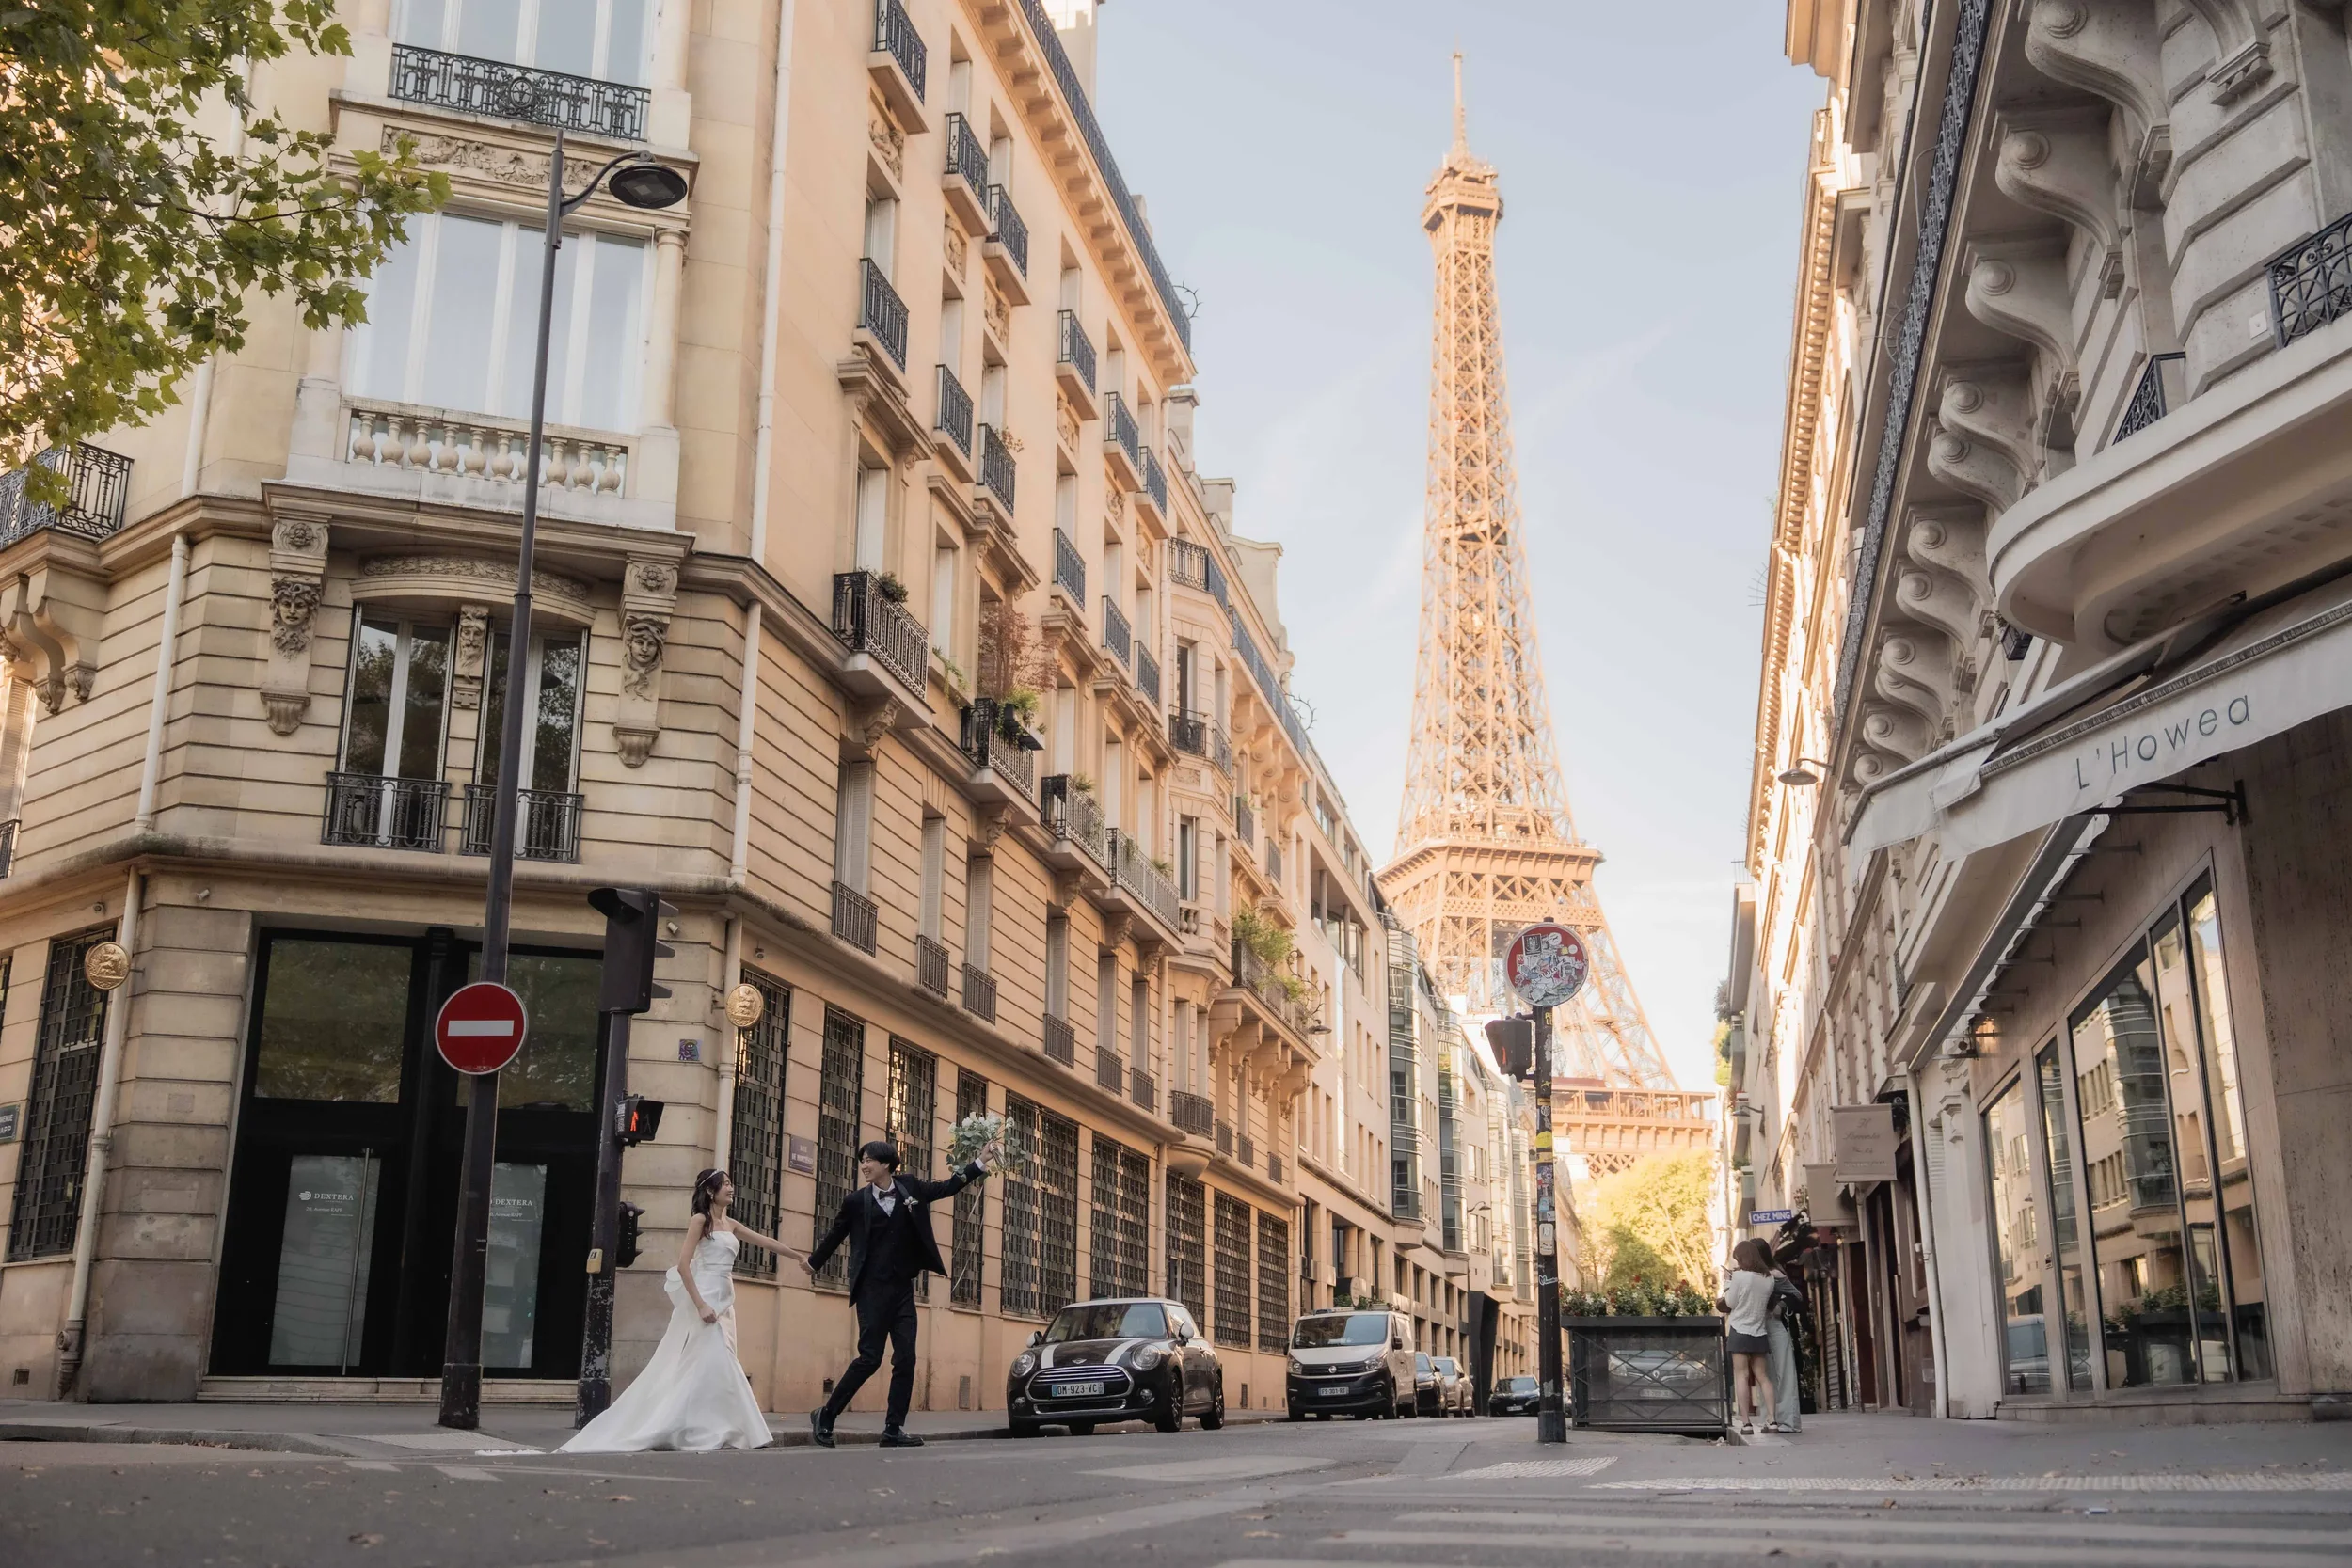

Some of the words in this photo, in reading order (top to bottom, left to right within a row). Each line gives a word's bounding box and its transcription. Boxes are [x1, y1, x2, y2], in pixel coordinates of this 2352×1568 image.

[2076, 694, 2249, 790] L'Howea
[0, 1125, 12, 1134] APP
[314, 1193, 354, 1201] DEXTERA
[1752, 1212, 1772, 1222] CHEZ
[1772, 1212, 1791, 1221] MING
